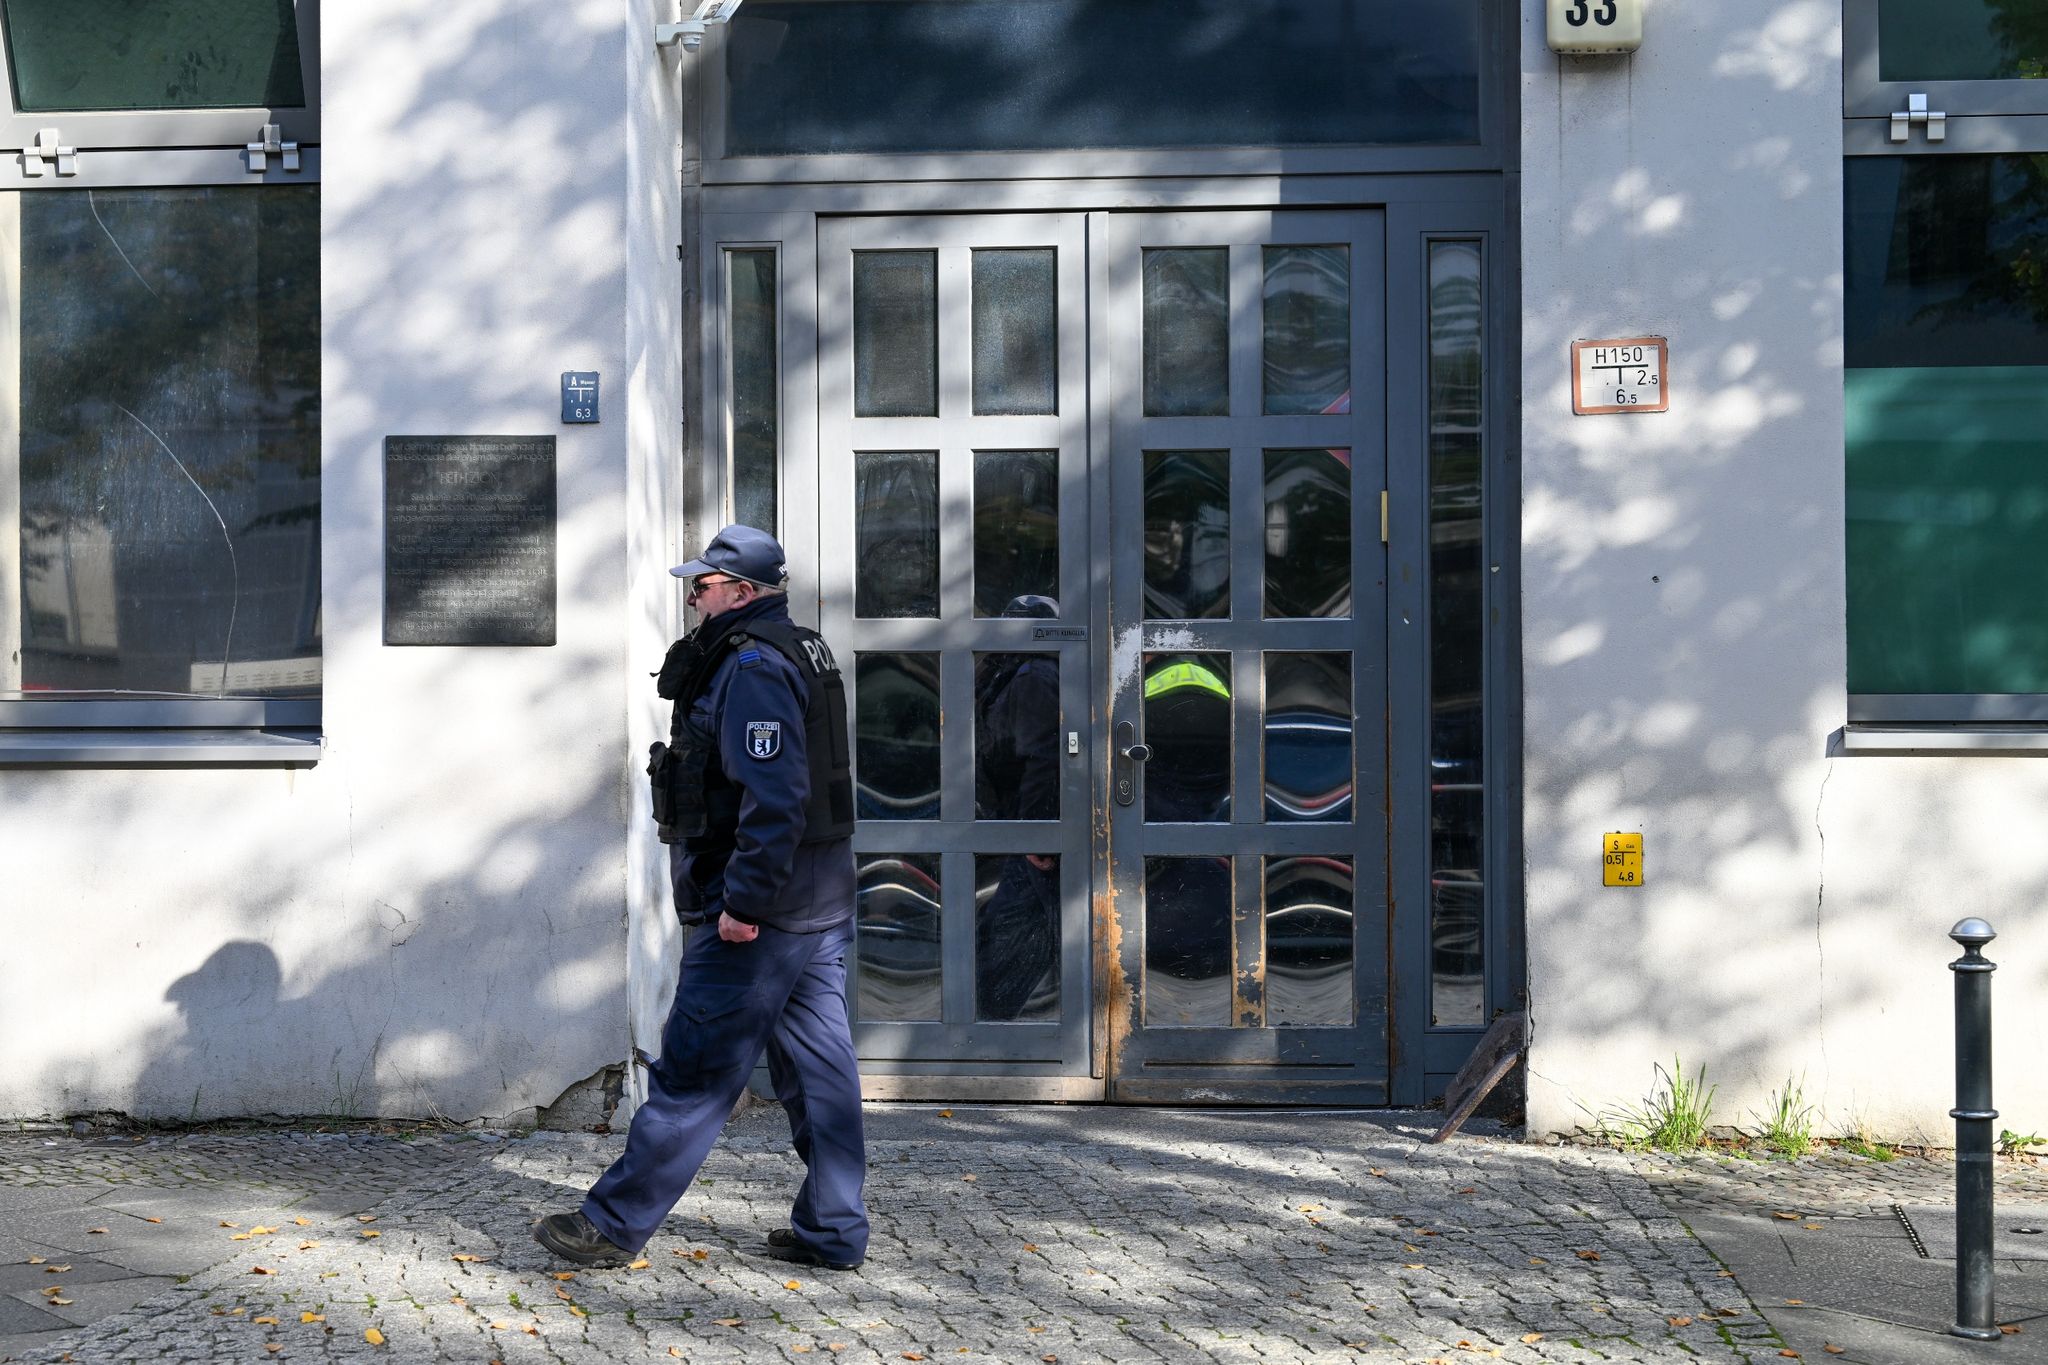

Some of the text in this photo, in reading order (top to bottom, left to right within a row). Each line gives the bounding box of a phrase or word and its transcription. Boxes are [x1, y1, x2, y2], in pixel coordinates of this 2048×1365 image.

[1565, 0, 1617, 27] 33
[1595, 346, 1643, 364] H150
[571, 376, 577, 387] A
[1637, 369, 1658, 386] 2.5
[1616, 388, 1637, 404] 6.5
[575, 408, 591, 420] 6,3
[749, 722, 778, 731] POLIZEI
[1618, 871, 1634, 882] 4.8
